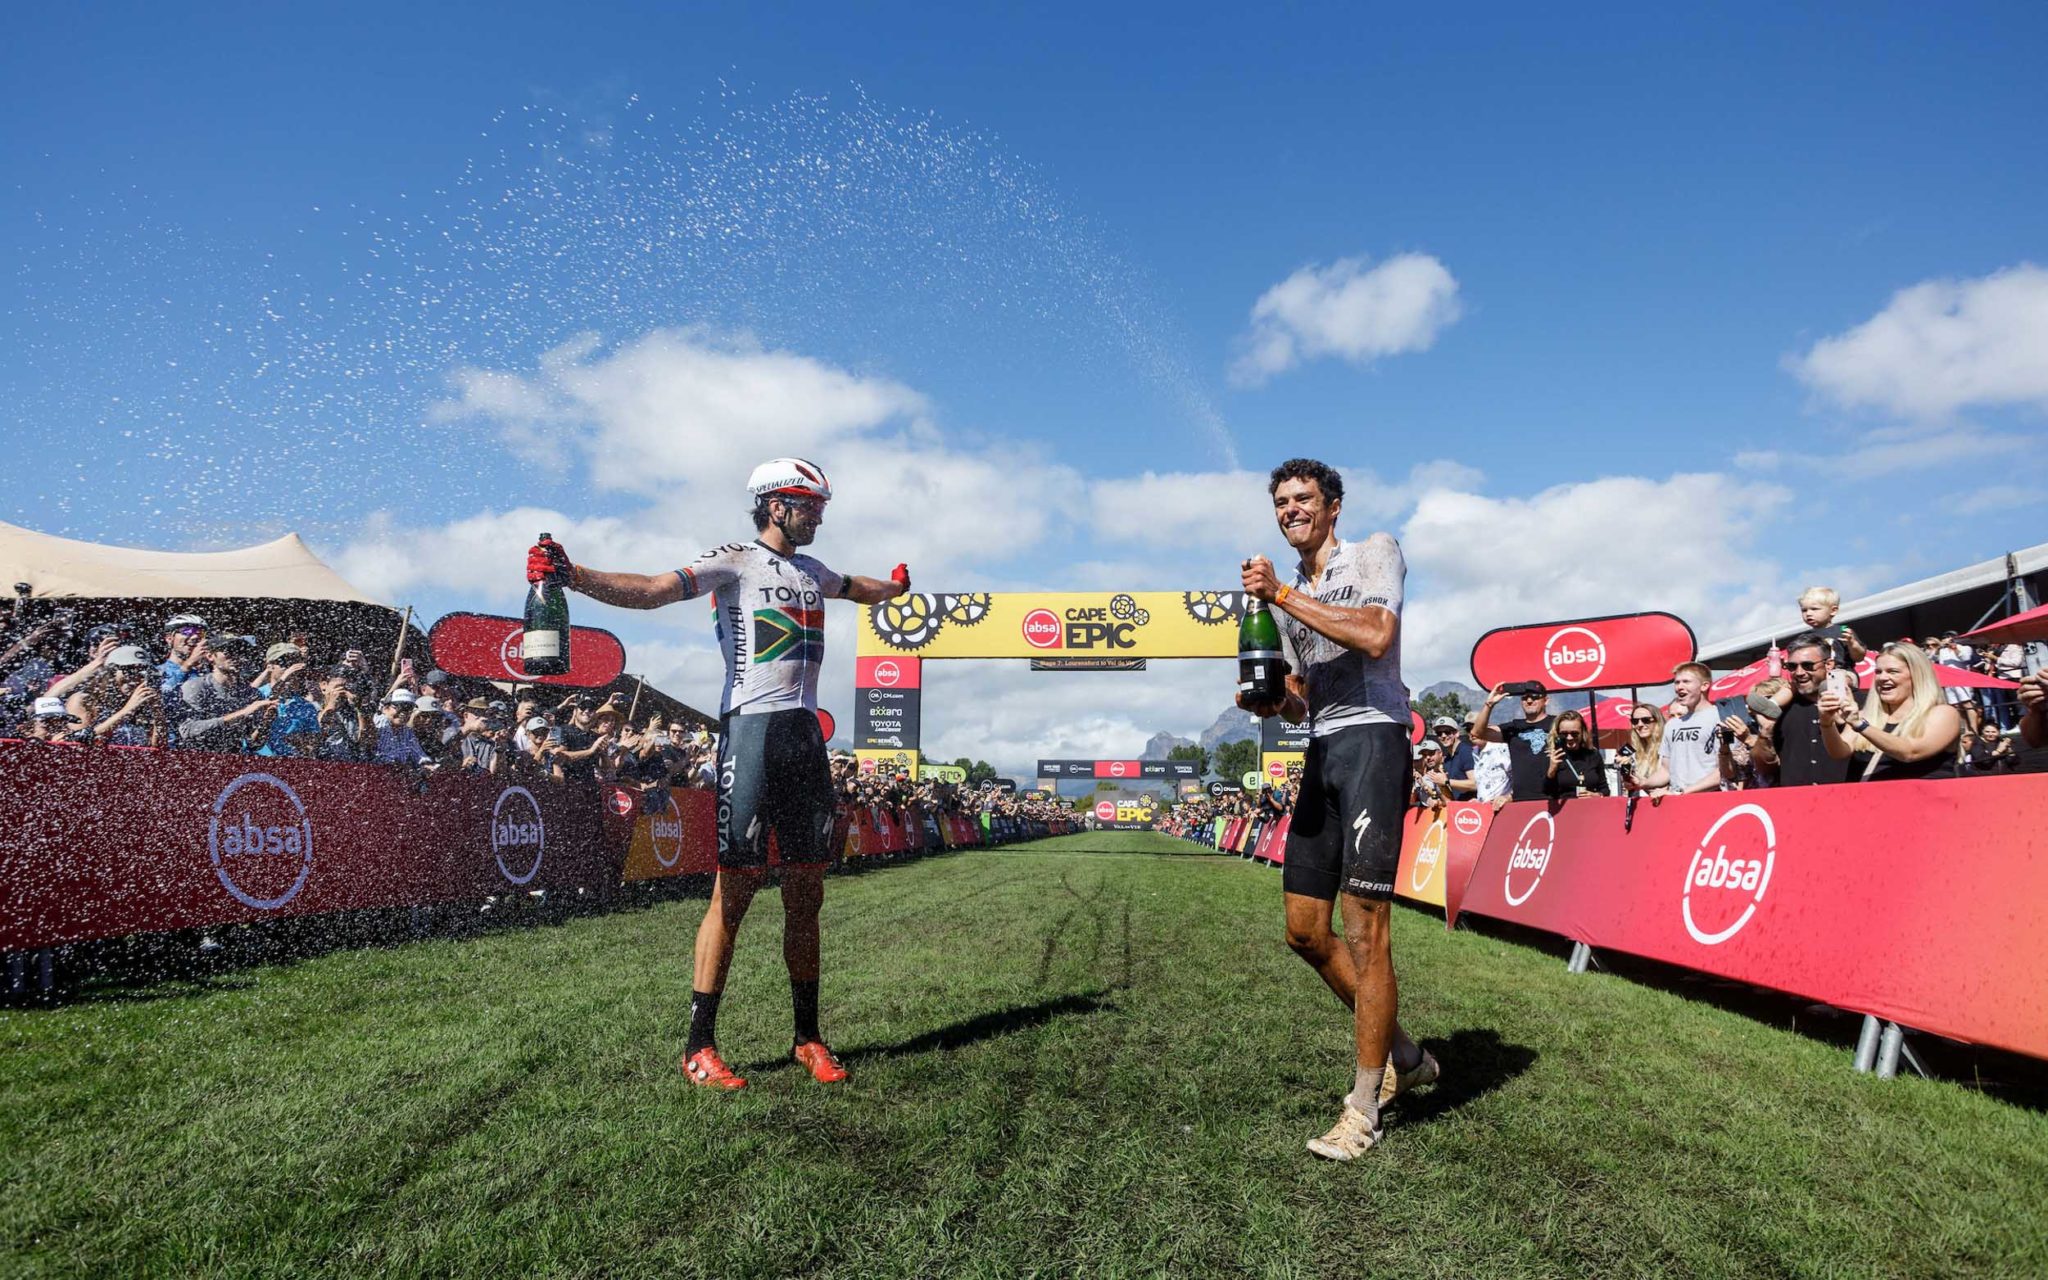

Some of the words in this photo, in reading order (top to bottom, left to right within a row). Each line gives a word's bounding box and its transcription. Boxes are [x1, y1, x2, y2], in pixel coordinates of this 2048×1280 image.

[755, 477, 804, 494] SPECIALIZED
[1065, 608, 1107, 621] CAPE
[1028, 621, 1056, 633] absa
[1066, 623, 1136, 649] EPIC
[728, 606, 747, 689] SPECIALIZED
[1551, 645, 1599, 665] absa
[878, 668, 898, 677] absa
[870, 706, 902, 716] exxaro
[1671, 727, 1702, 743] VANS
[877, 764, 907, 774] EPIC
[719, 755, 736, 852] TOYOTA
[1117, 808, 1153, 822] EPIC
[1456, 816, 1480, 826] absa
[223, 812, 302, 855] absa
[499, 814, 538, 846] absa
[655, 817, 679, 838] absa
[1419, 846, 1438, 865] absa
[1513, 840, 1545, 870] absa
[1695, 845, 1762, 890] absa
[1349, 877, 1394, 892] SRAM
